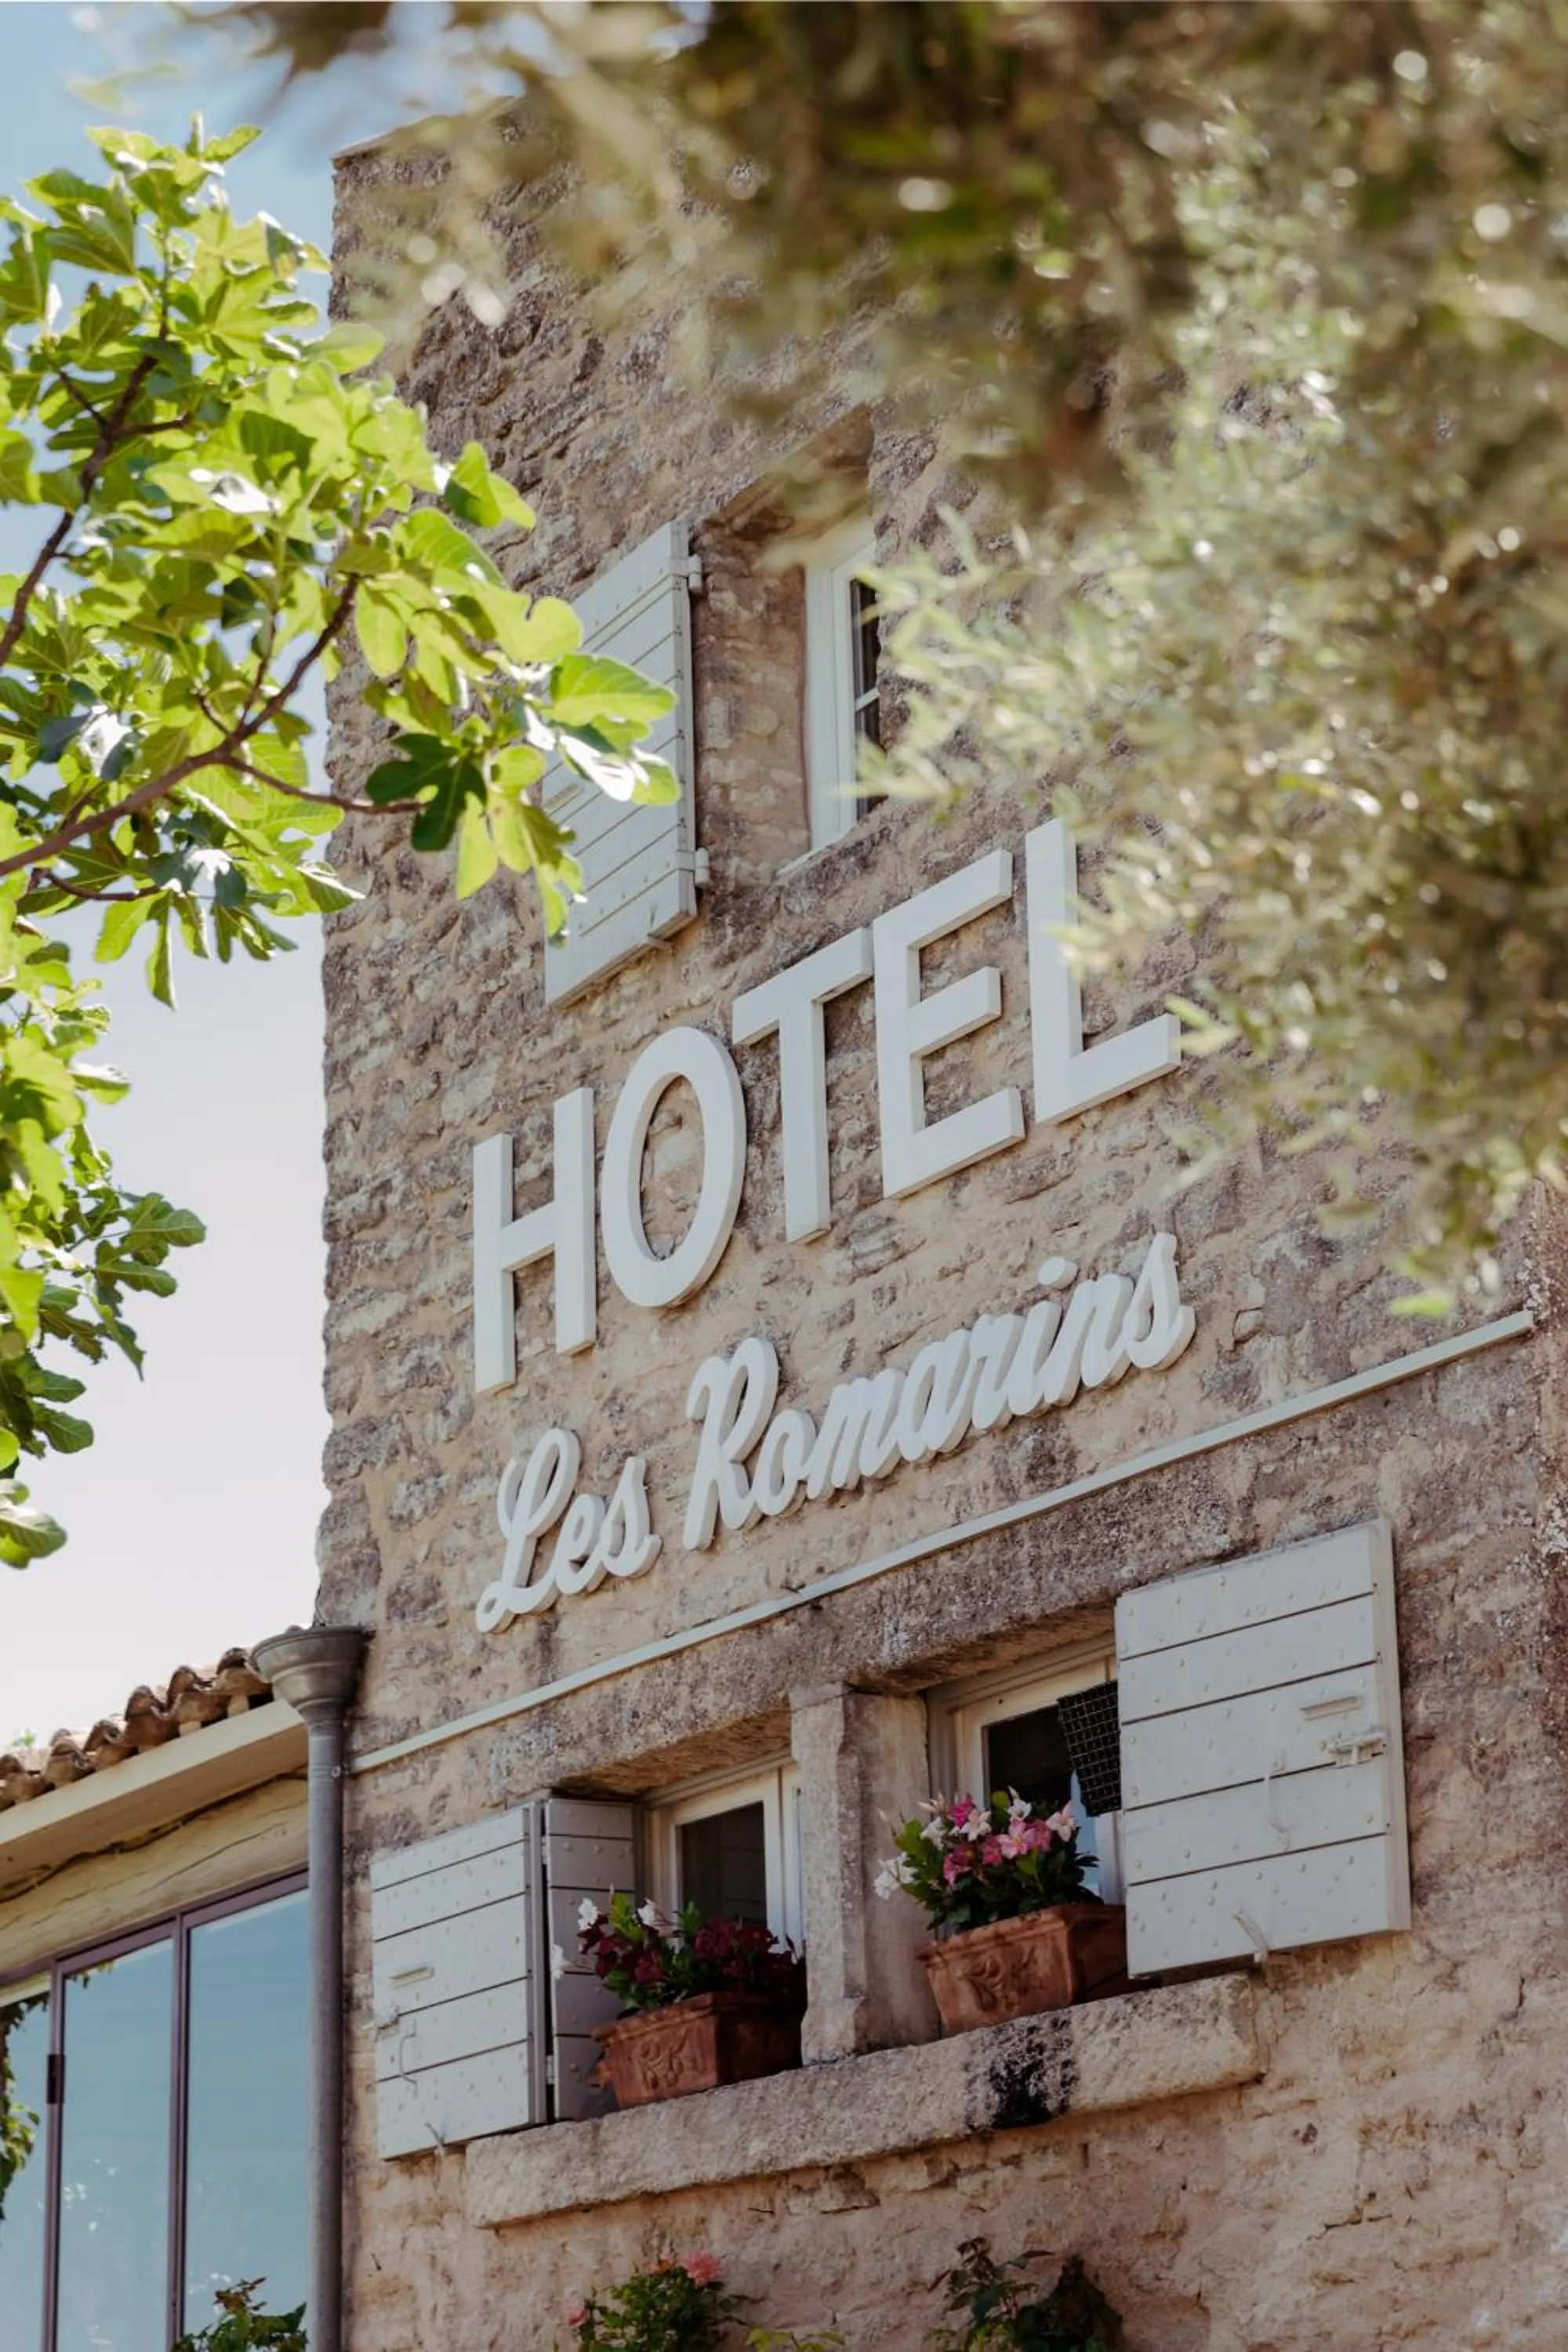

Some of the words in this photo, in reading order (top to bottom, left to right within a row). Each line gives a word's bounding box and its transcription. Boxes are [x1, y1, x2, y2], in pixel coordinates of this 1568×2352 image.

[474, 818, 1181, 1394] HOTEL
[475, 1428, 662, 1634] Les
[684, 1232, 1196, 1552] Romarins
